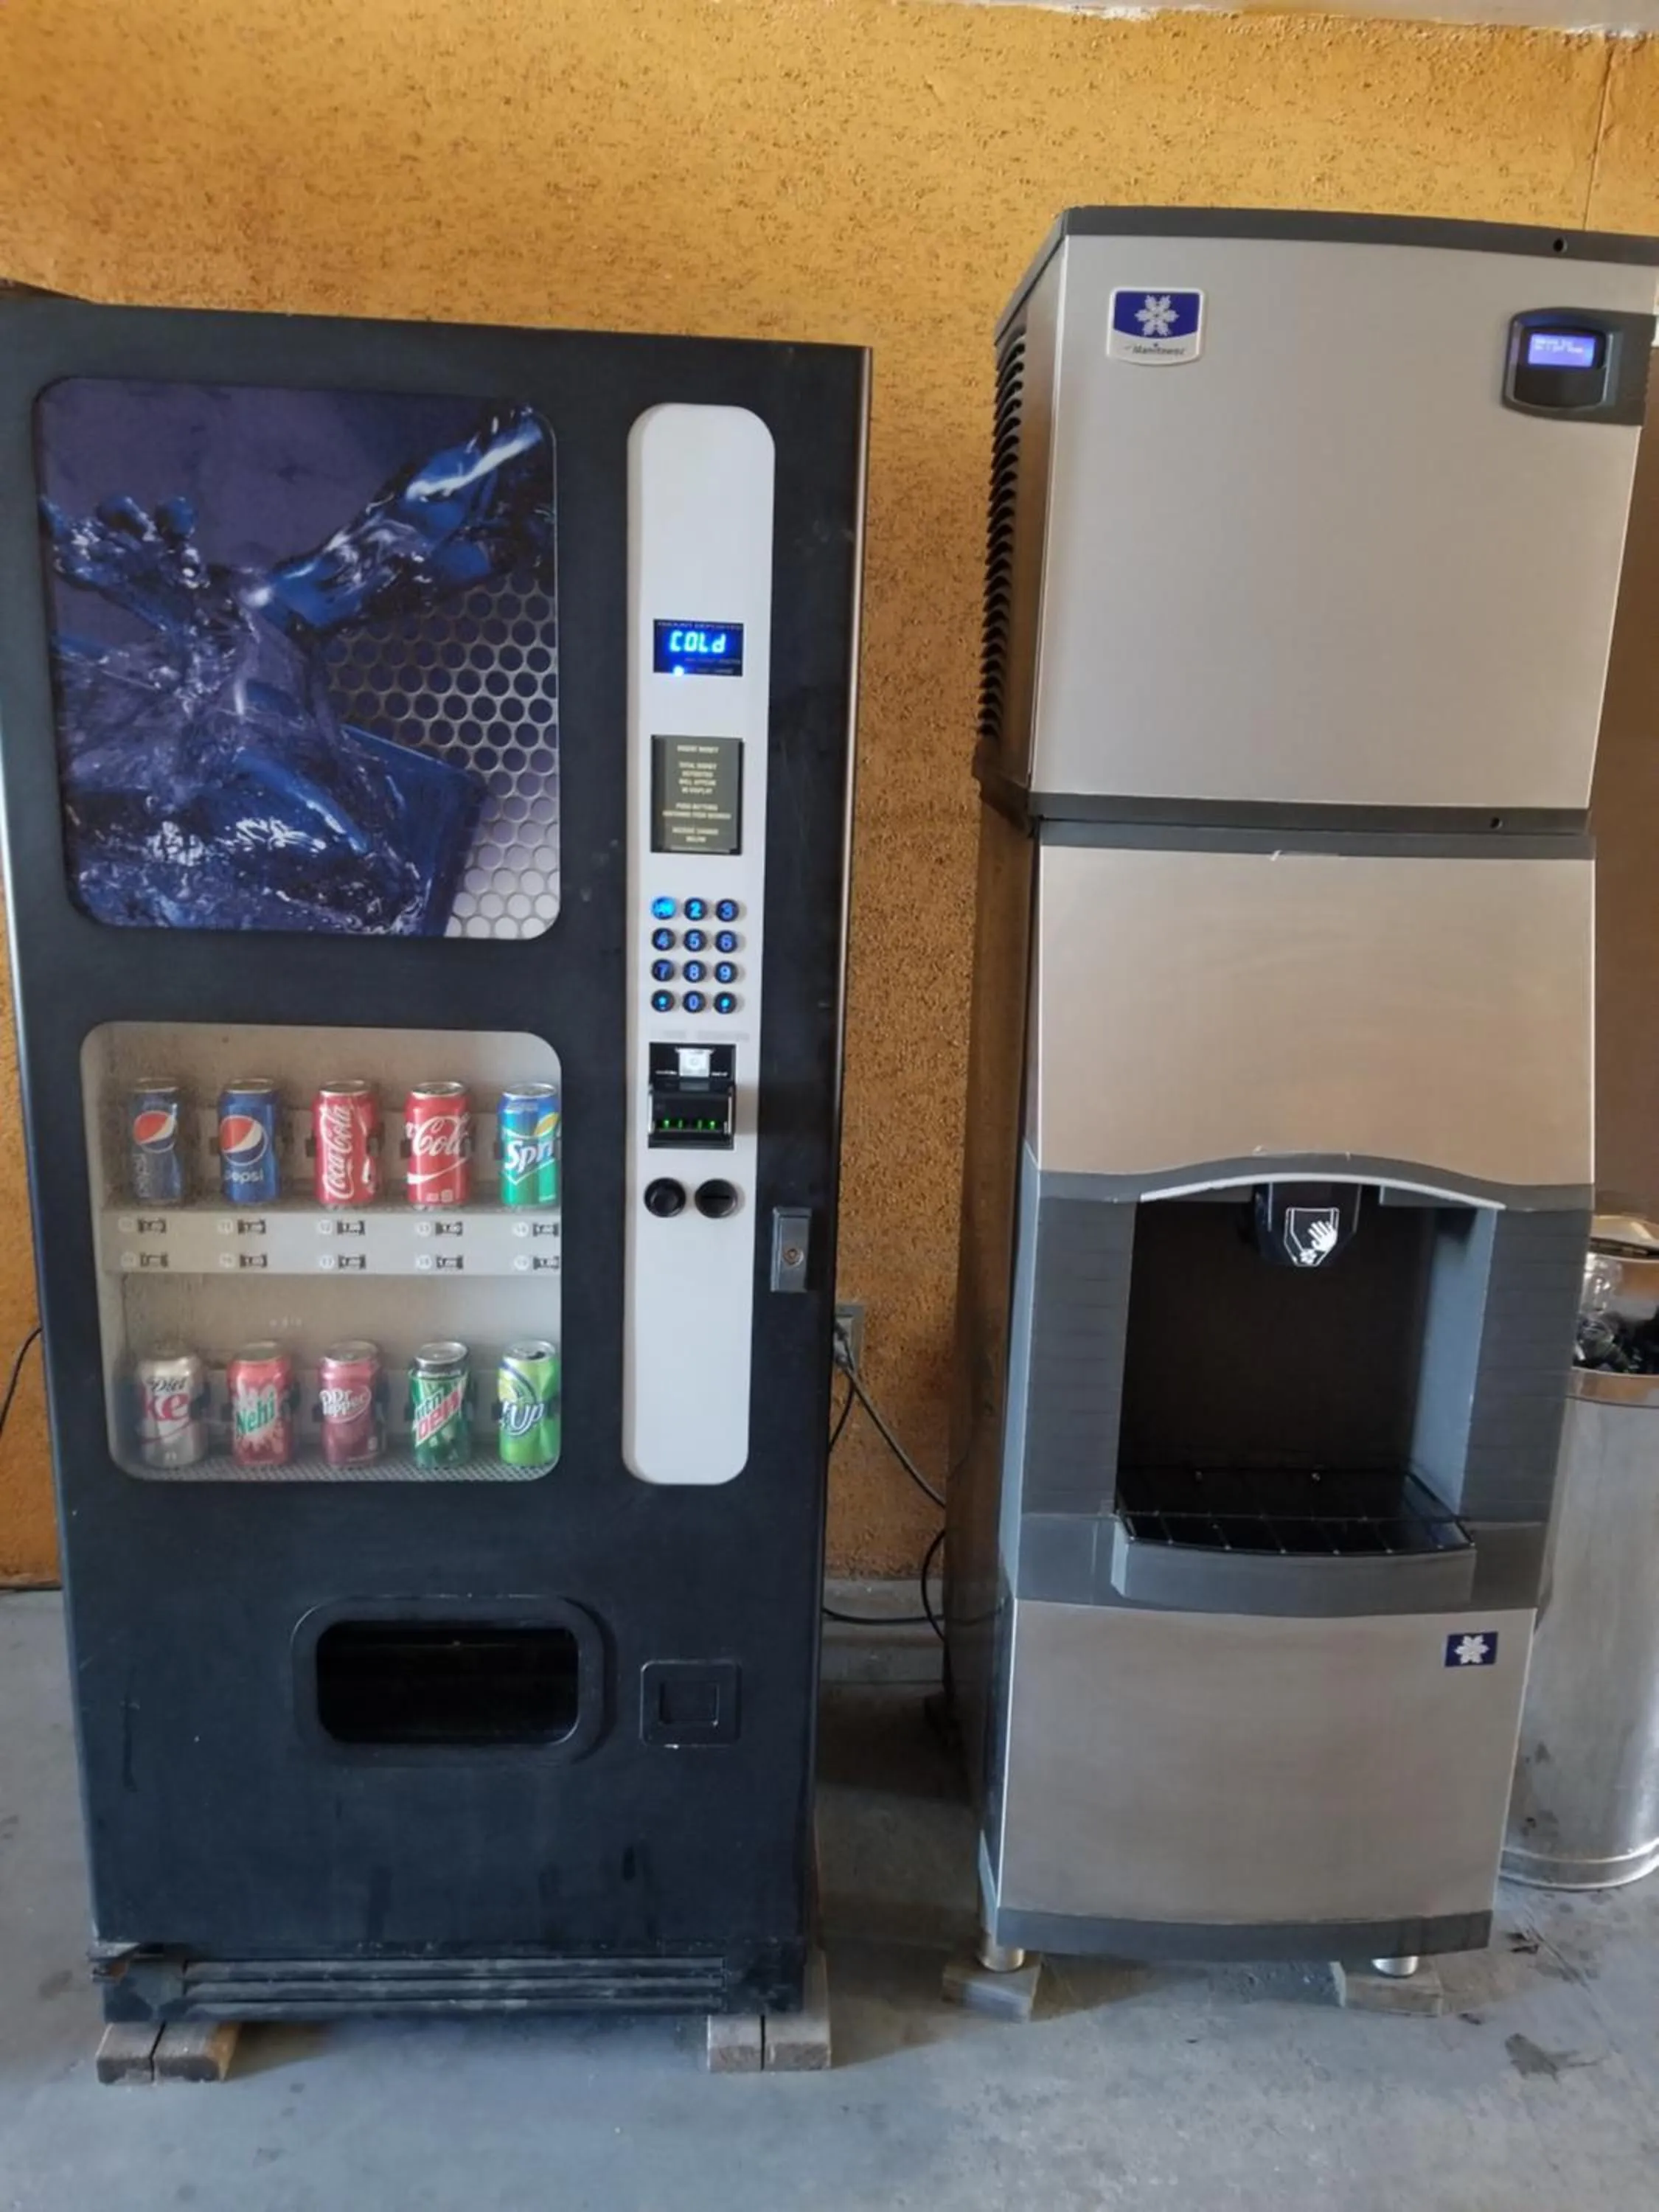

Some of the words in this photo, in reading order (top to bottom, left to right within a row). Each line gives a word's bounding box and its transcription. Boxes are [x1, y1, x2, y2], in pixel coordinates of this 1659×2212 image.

[689, 901, 701, 918] 2
[721, 902, 733, 919] 3
[657, 931, 668, 948] 4
[689, 933, 700, 949] 5
[658, 962, 669, 979] 7
